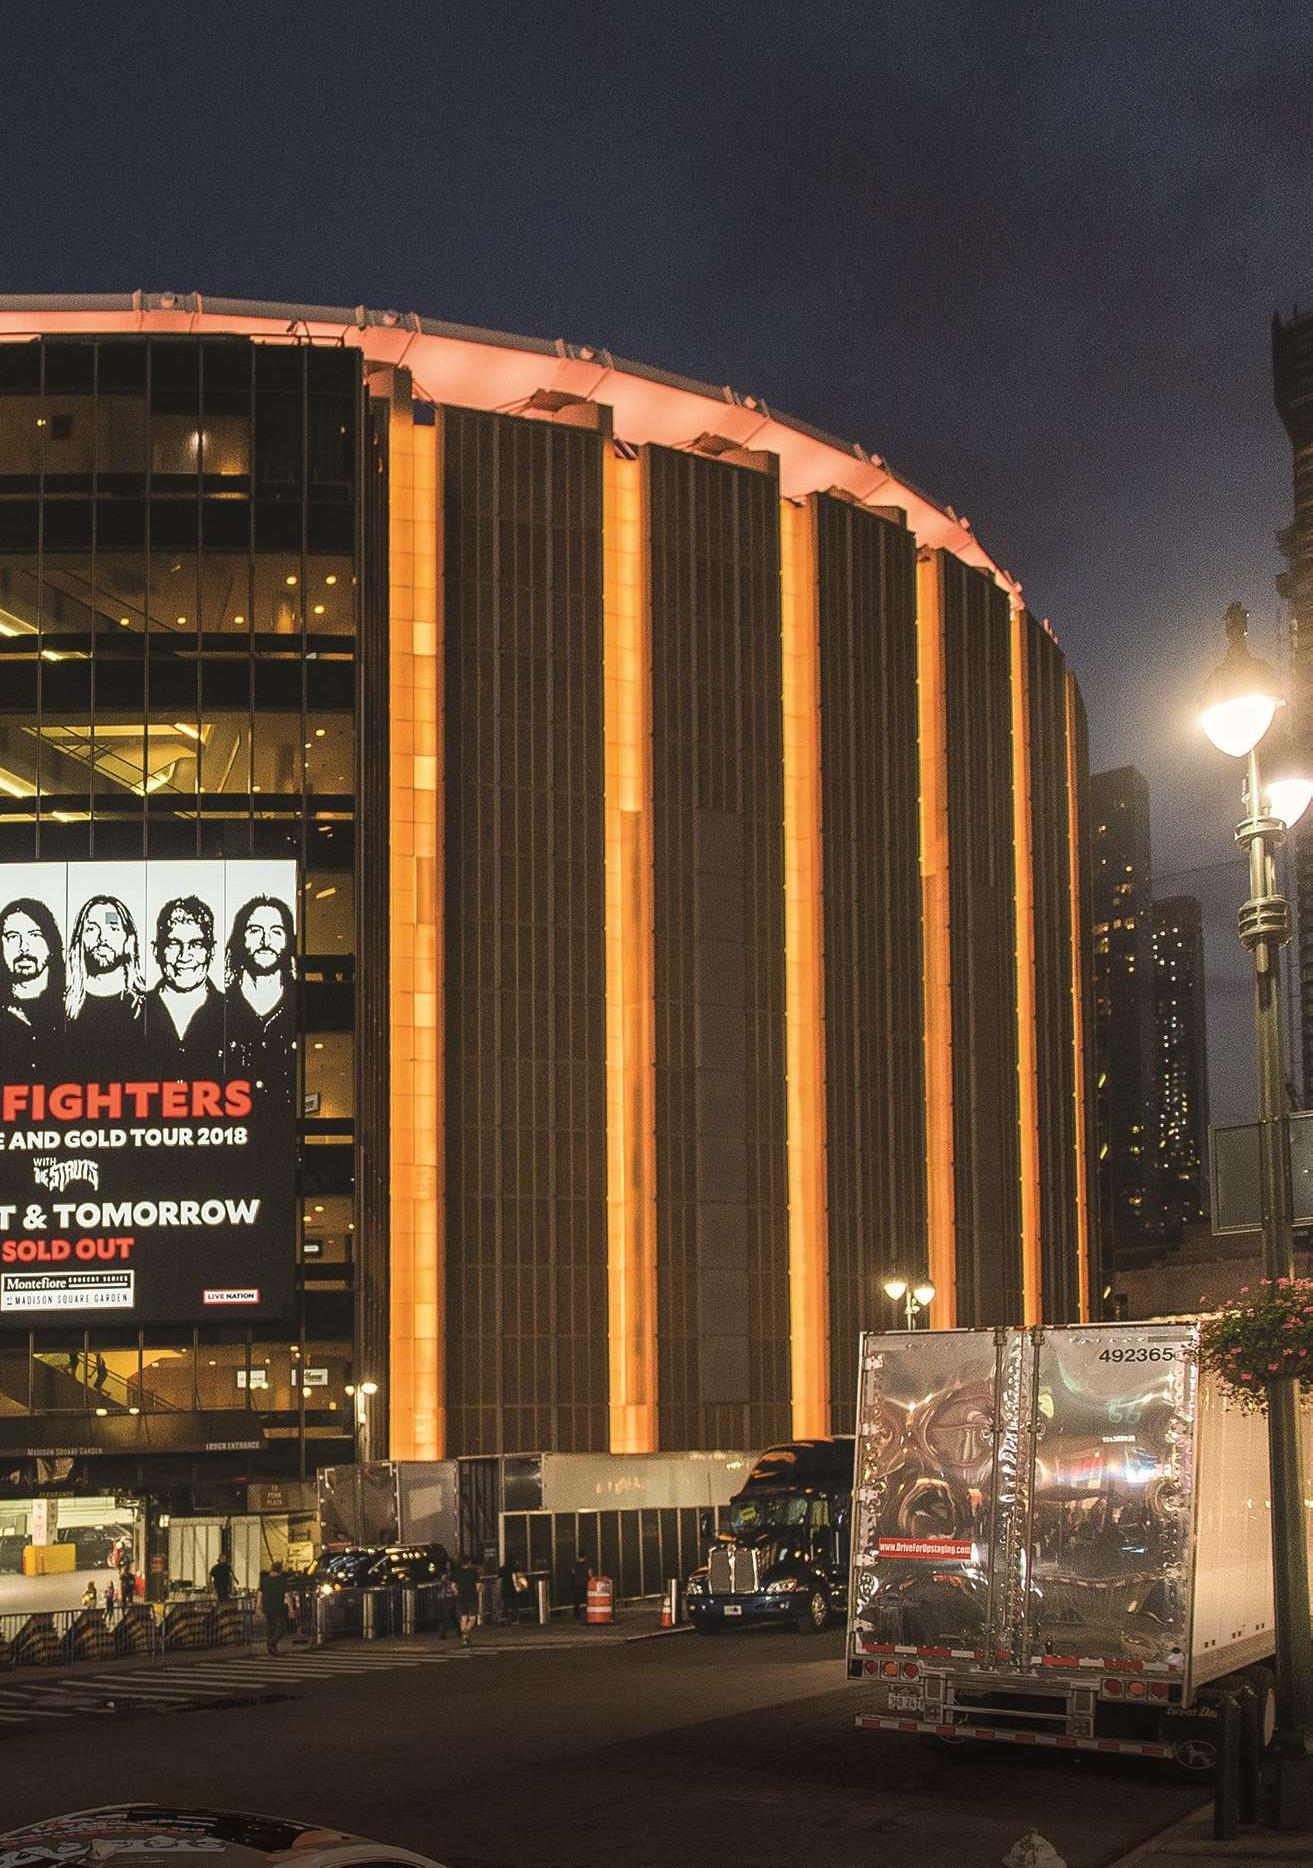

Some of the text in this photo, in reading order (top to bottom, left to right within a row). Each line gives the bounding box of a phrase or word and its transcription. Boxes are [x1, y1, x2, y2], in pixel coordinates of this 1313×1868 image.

[2, 1080, 253, 1122] FIGHTERS
[9, 1131, 61, 1150] AND
[64, 1129, 126, 1149] GOLD
[131, 1128, 193, 1147] TOUR
[197, 1127, 248, 1146] 2018
[33, 1157, 56, 1166] WITH
[49, 1159, 99, 1192] STRUTS
[23, 1205, 47, 1230] &
[53, 1199, 260, 1228] TOMORROW
[2, 1237, 135, 1262] SOLD OUT
[6, 1276, 68, 1290] Montefiore
[15, 1294, 54, 1305] MADISON
[57, 1293, 90, 1304] SQUARE
[94, 1293, 129, 1303] GARDEN
[1099, 1348, 1175, 1362] 492365
[879, 1542, 971, 1555] www.DriveForUpstaging.com
